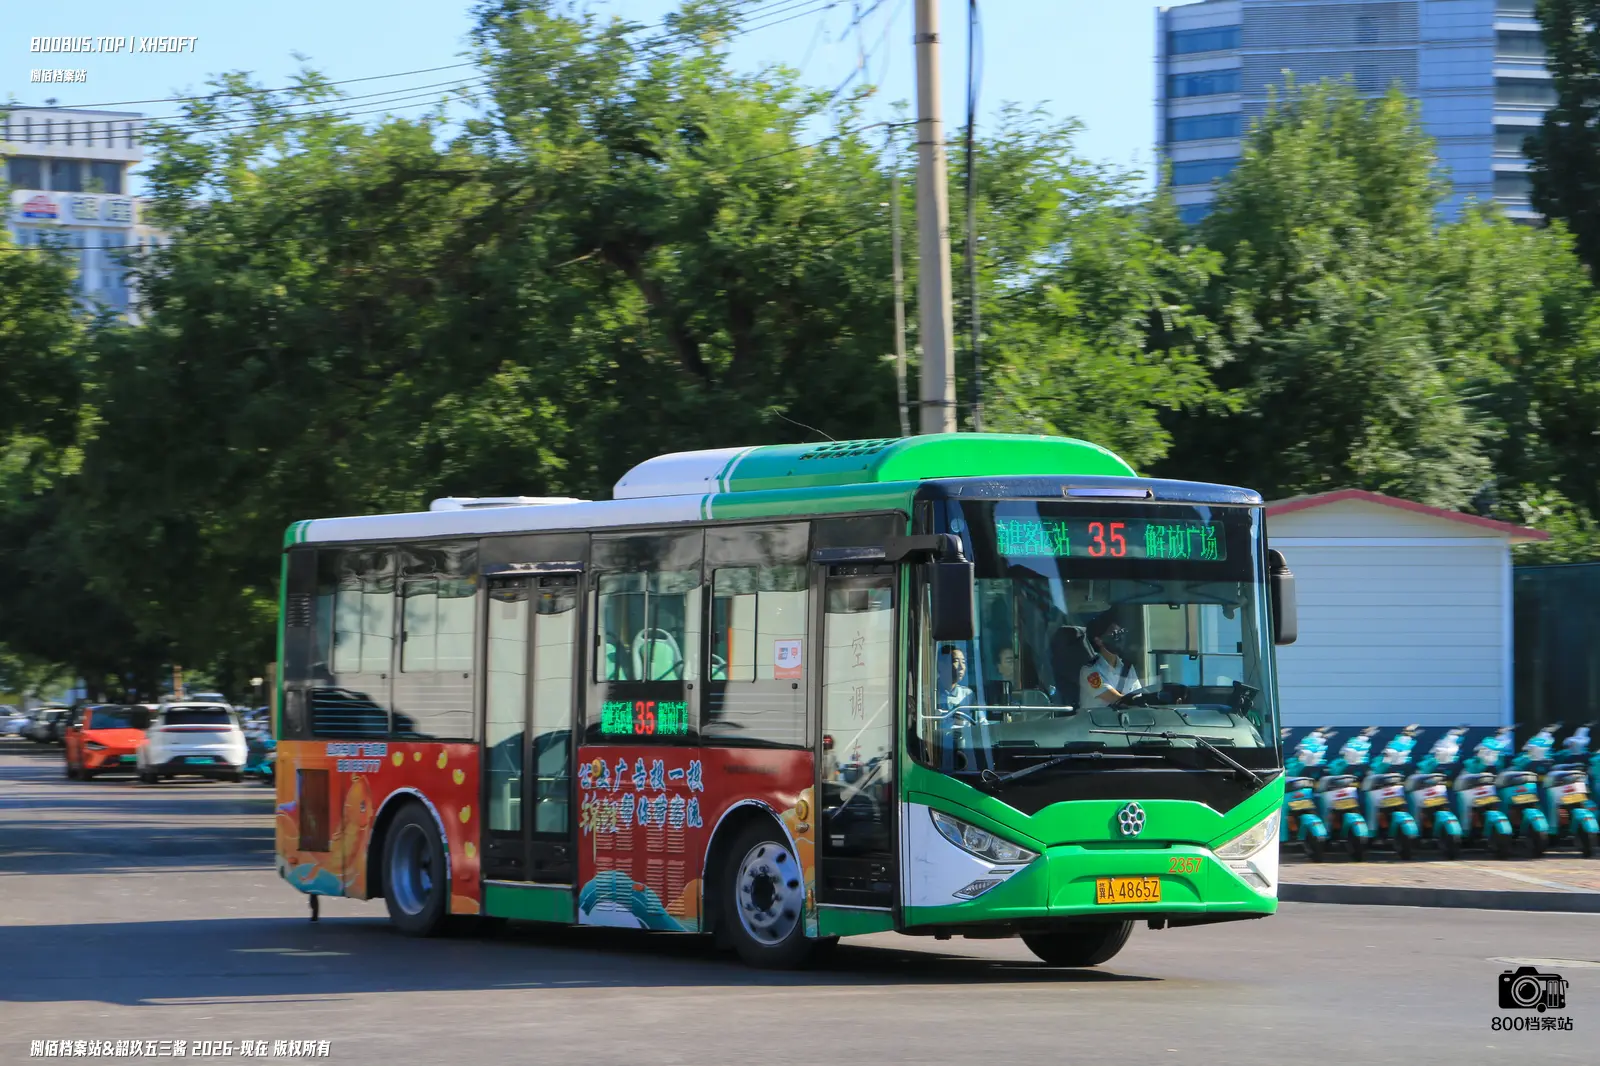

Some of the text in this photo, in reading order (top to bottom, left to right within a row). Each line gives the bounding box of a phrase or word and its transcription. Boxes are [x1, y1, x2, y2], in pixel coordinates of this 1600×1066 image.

[1087, 521, 1127, 558] 35
[1144, 523, 1219, 560] 解放广场
[635, 700, 656, 735] 35
[1168, 857, 1202, 874] 2357
